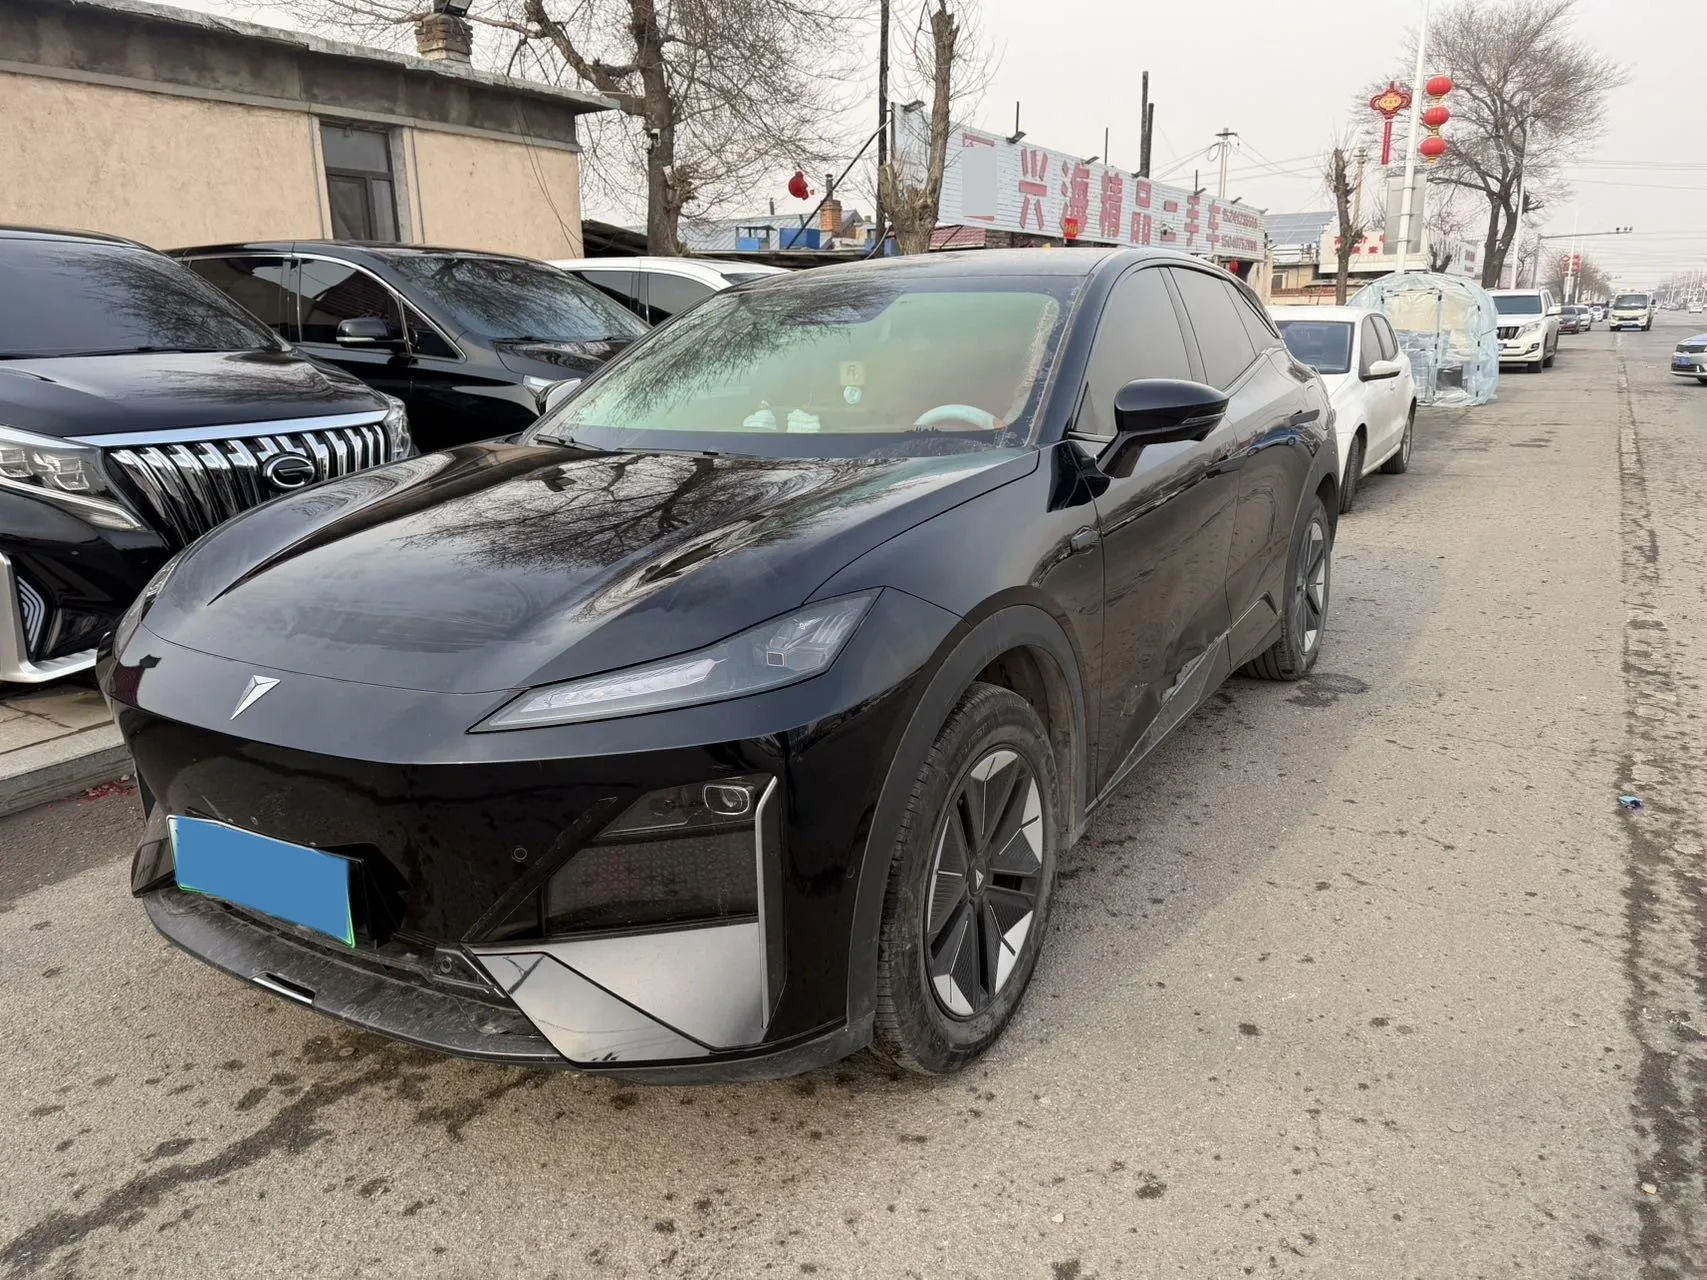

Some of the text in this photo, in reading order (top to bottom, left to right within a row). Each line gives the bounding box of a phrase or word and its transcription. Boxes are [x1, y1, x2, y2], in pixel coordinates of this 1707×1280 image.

[962, 132, 1221, 250] 兴海精品二手车
